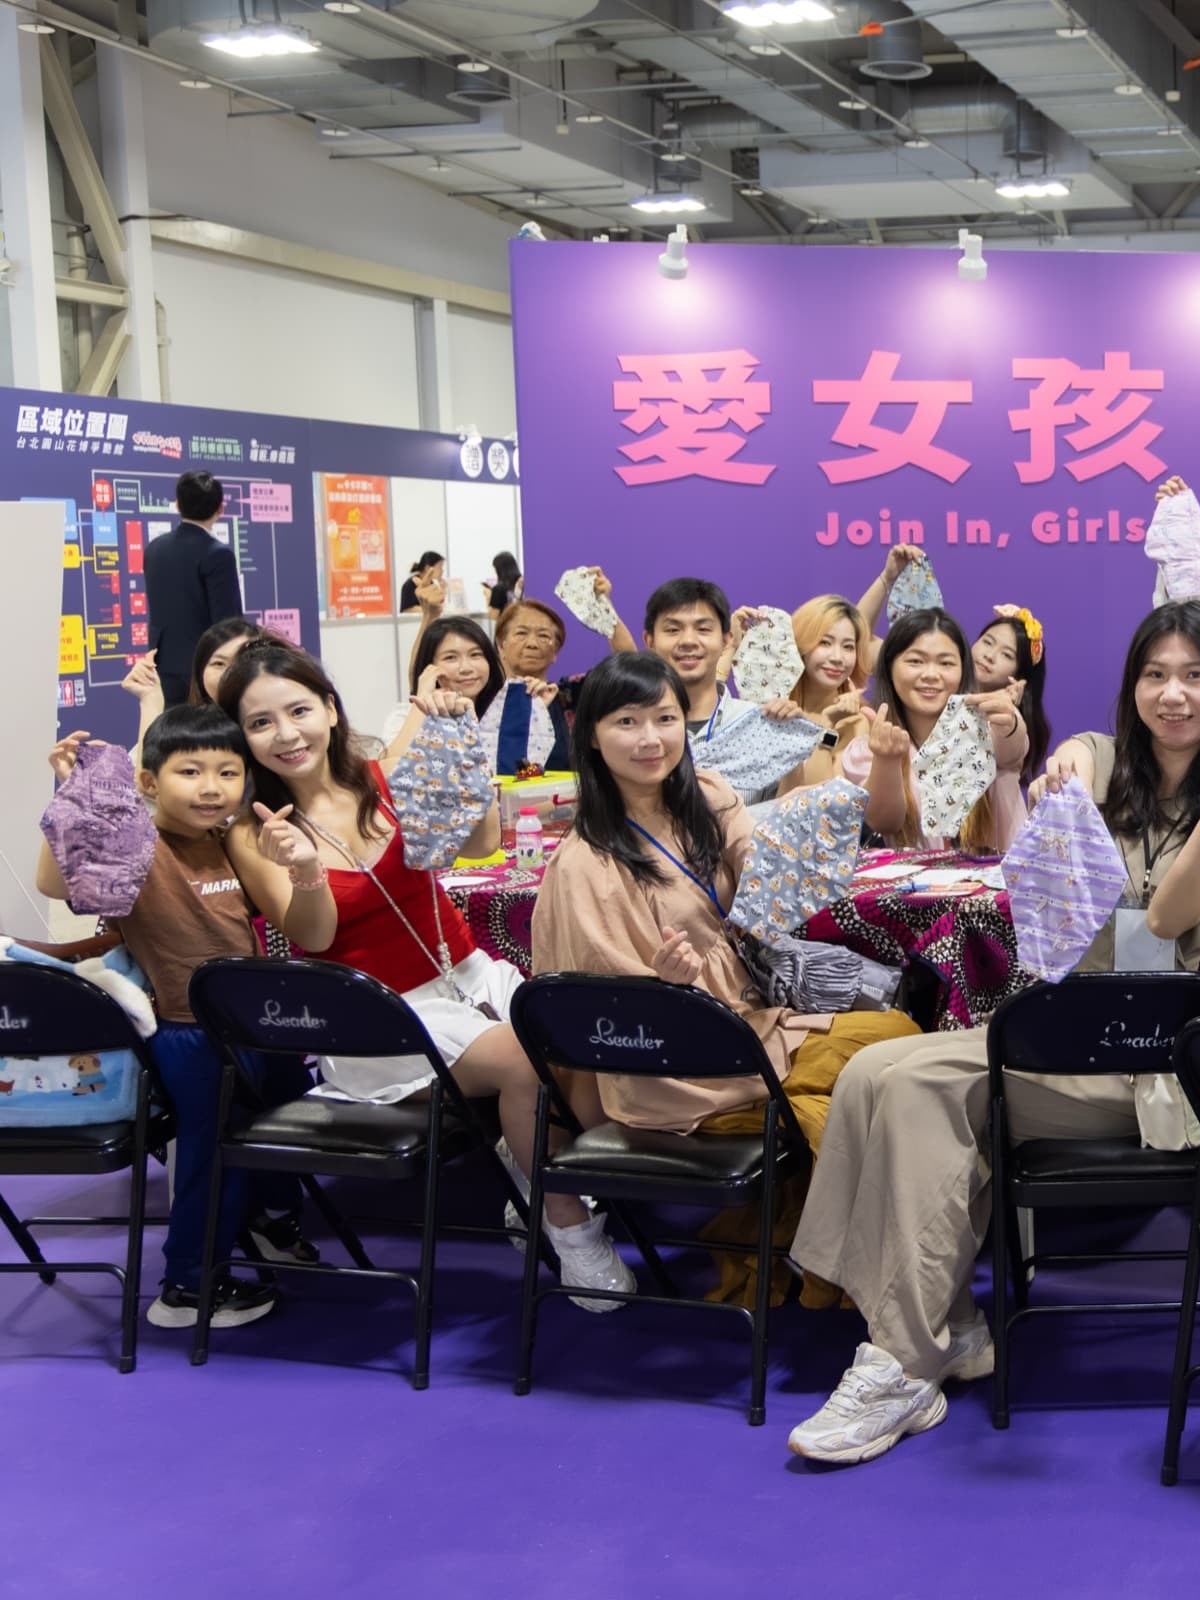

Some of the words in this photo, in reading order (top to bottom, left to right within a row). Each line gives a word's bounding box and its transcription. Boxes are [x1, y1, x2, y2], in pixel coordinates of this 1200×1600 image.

[16, 405, 129, 441] 區域位置圖
[612, 347, 1170, 488] 愛女孩
[815, 508, 925, 546] Join
[946, 511, 1010, 549] In,
[1031, 507, 1146, 543] Girls
[259, 999, 328, 1029] Leader
[589, 1017, 664, 1049] Leader
